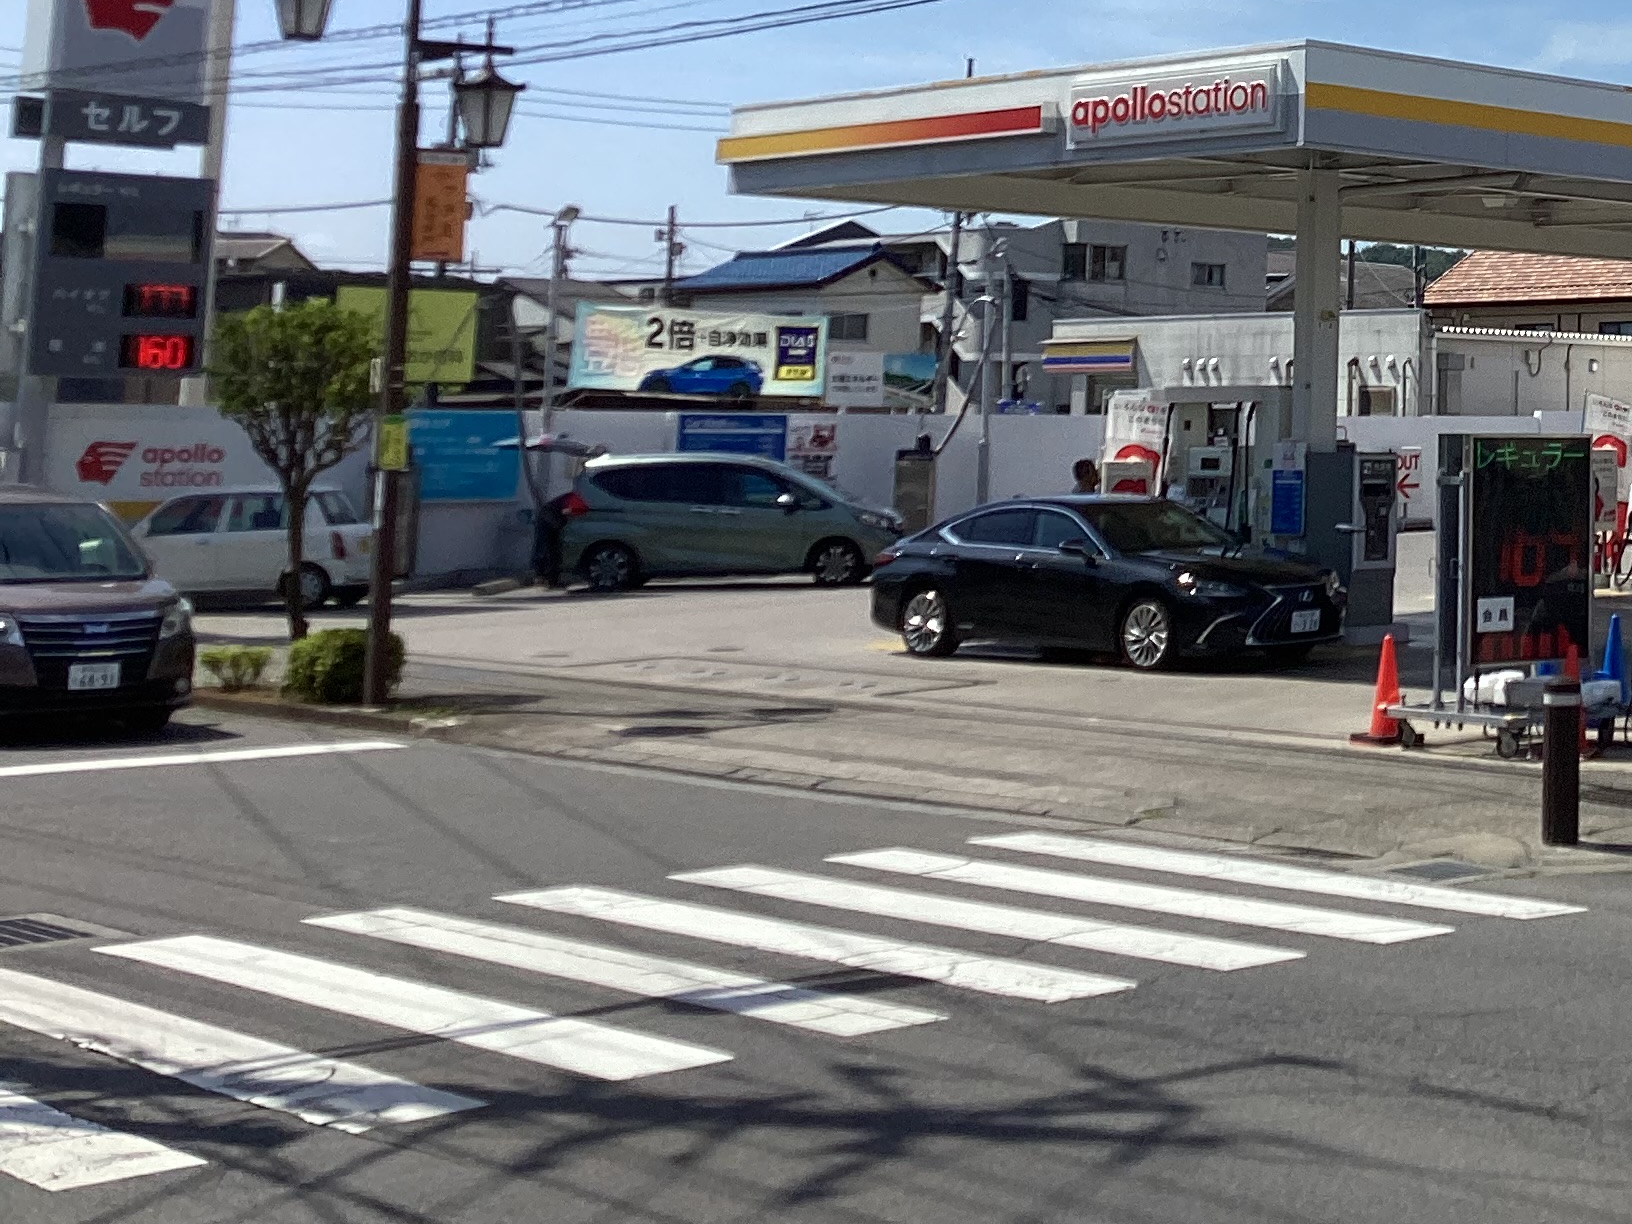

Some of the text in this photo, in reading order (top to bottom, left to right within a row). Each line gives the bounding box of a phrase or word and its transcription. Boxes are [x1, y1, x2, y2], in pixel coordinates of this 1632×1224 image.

[81, 100, 183, 136] セルフ
[1071, 78, 1267, 134] apollostation
[138, 336, 187, 369] 160
[141, 443, 226, 468] apollo
[1477, 441, 1585, 471] レギュラー
[140, 468, 223, 487] station
[1482, 607, 1509, 624] 会員
